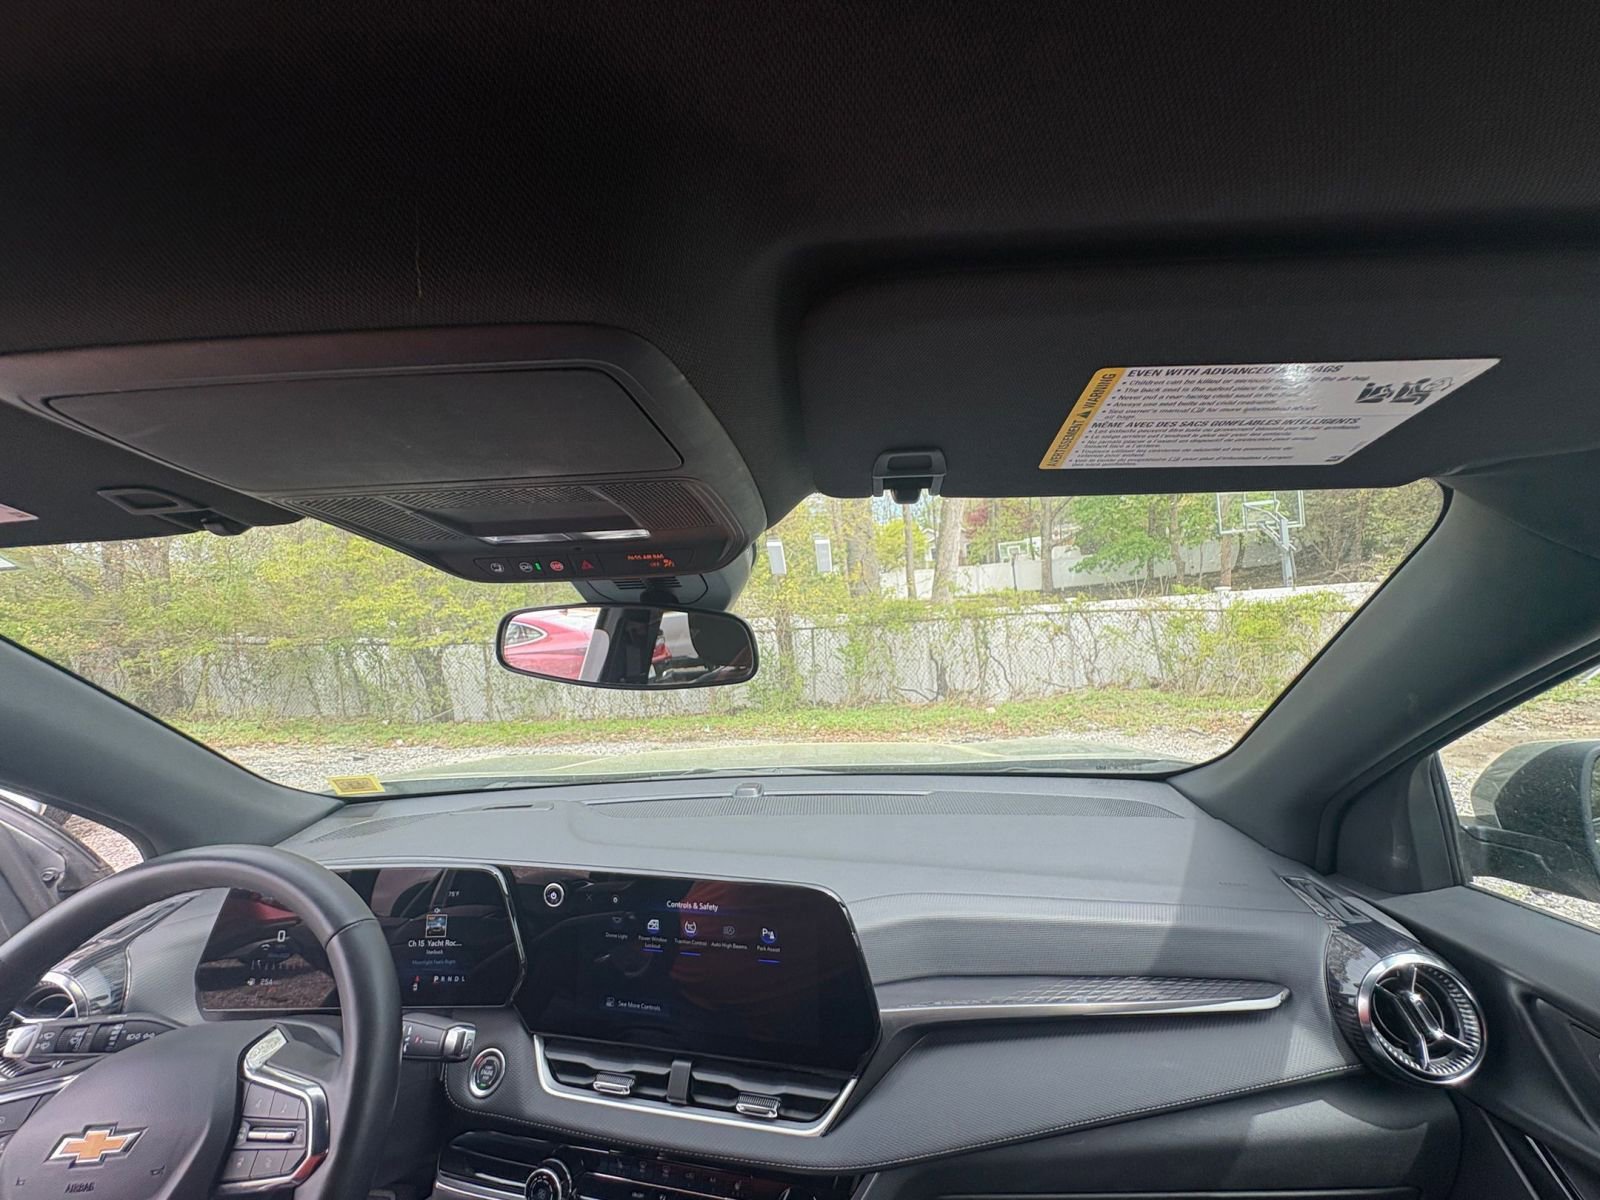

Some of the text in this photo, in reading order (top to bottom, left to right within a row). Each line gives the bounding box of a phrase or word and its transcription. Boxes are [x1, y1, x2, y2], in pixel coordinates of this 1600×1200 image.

[1127, 369, 1163, 377] EVEN
[1165, 368, 1200, 376] WITH
[1200, 367, 1276, 375] ADVANCED
[1082, 373, 1117, 409] WARNING
[1091, 420, 1124, 428] MÊME
[1047, 420, 1085, 467] AVERTISSEMENT
[666, 900, 718, 912] Controls & Safety
[276, 930, 286, 942] 0
[433, 975, 439, 983] P
[641, 1003, 661, 1011] Controls
[64, 1181, 95, 1193] AIRBAG
